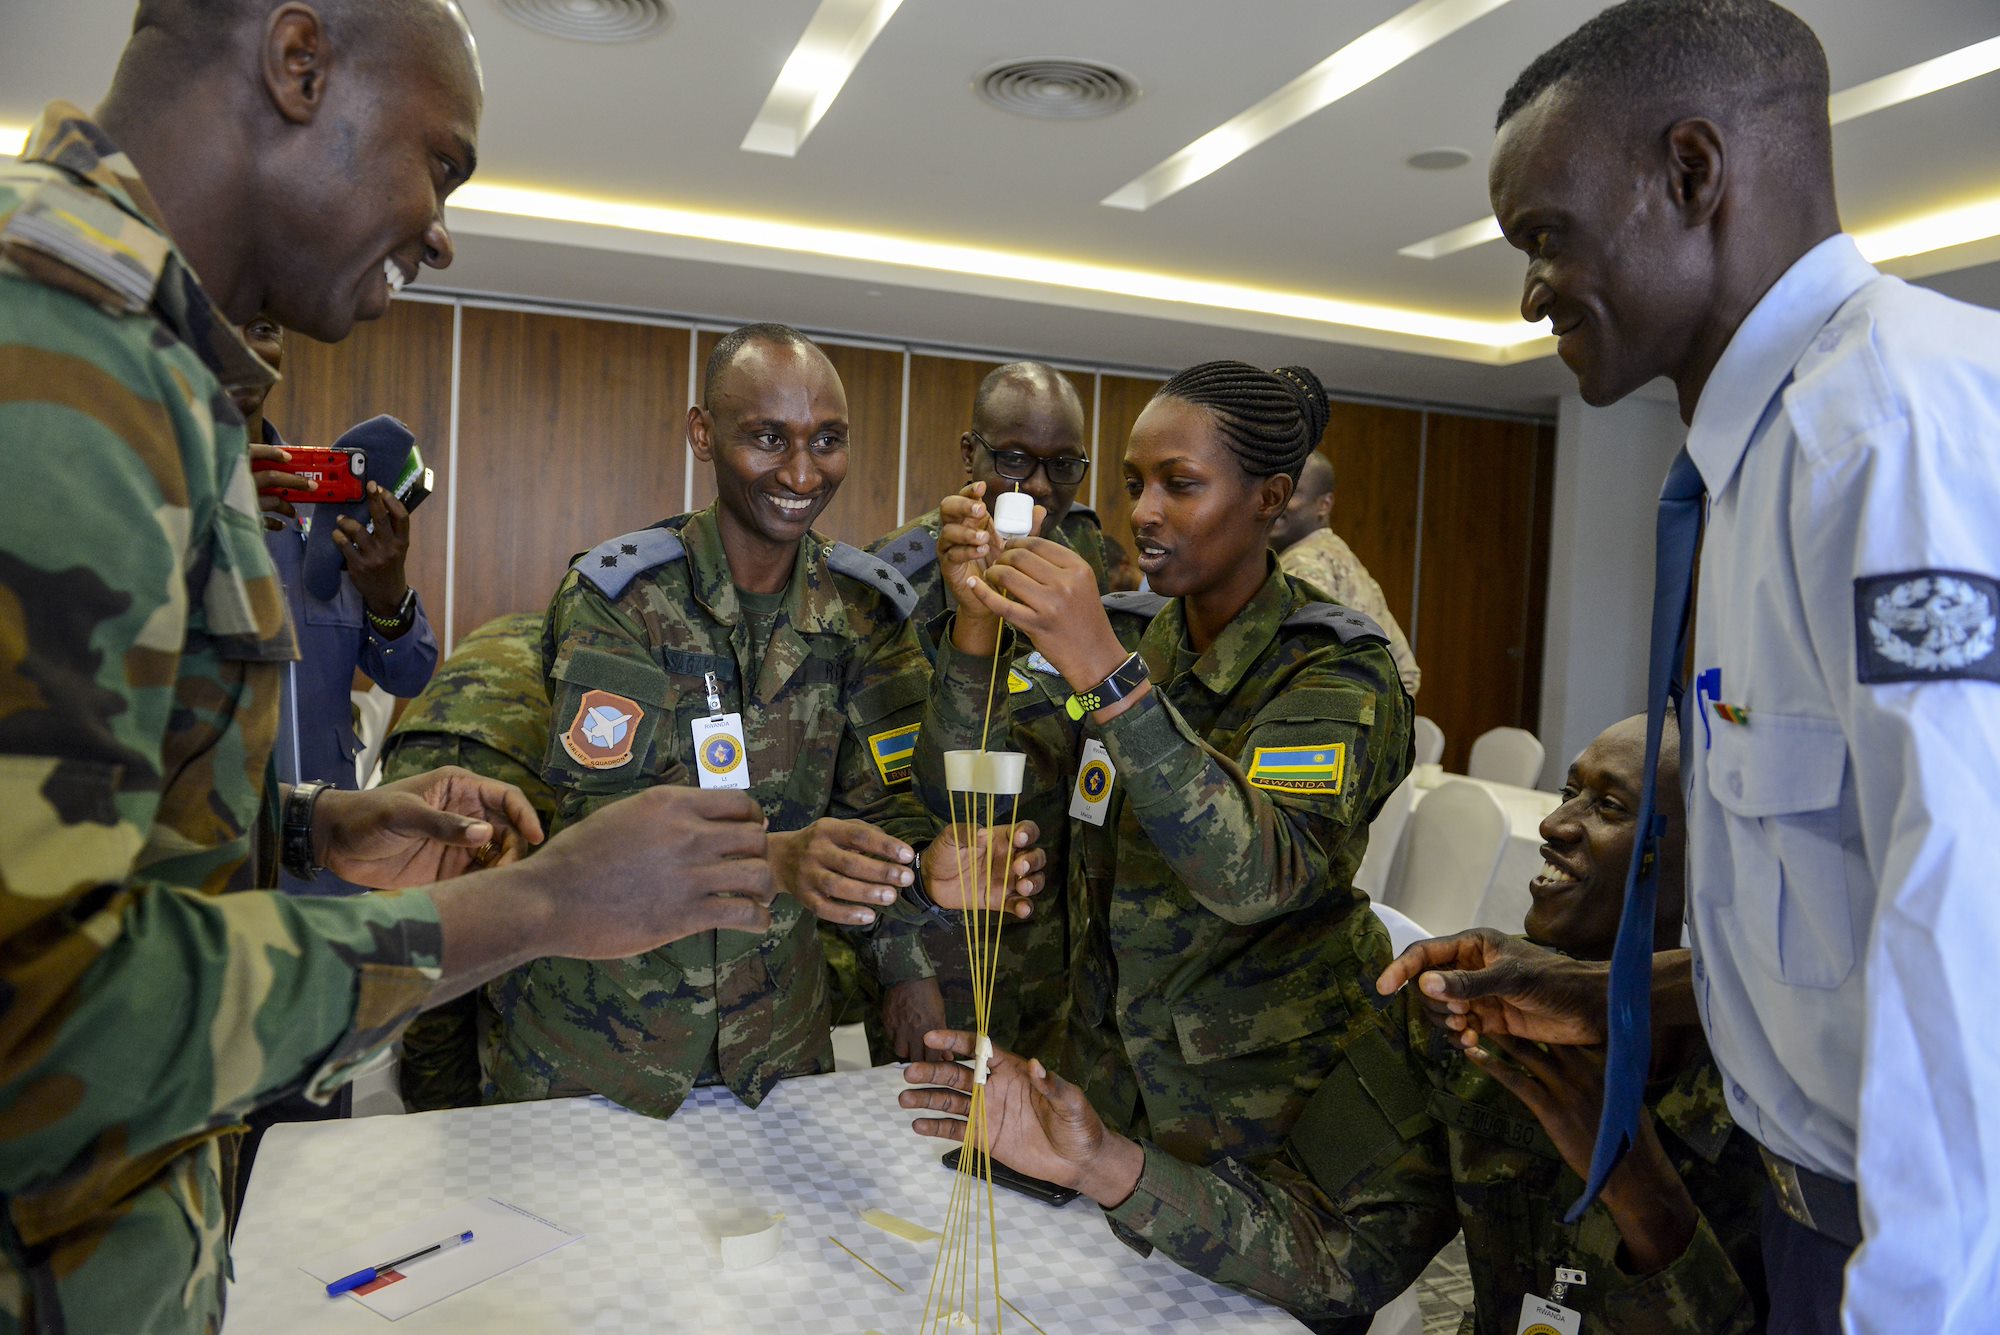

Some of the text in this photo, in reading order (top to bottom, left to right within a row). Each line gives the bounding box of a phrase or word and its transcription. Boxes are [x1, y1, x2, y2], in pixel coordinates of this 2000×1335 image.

[704, 721, 730, 729] RWANDA
[567, 742, 626, 766] AIRLIFT SQUADRON
[891, 767, 911, 780] RWA
[1259, 778, 1326, 789] RWANDA
[1472, 1108, 1535, 1145] MUGABO
[1536, 1306, 1566, 1322] RWANDA
